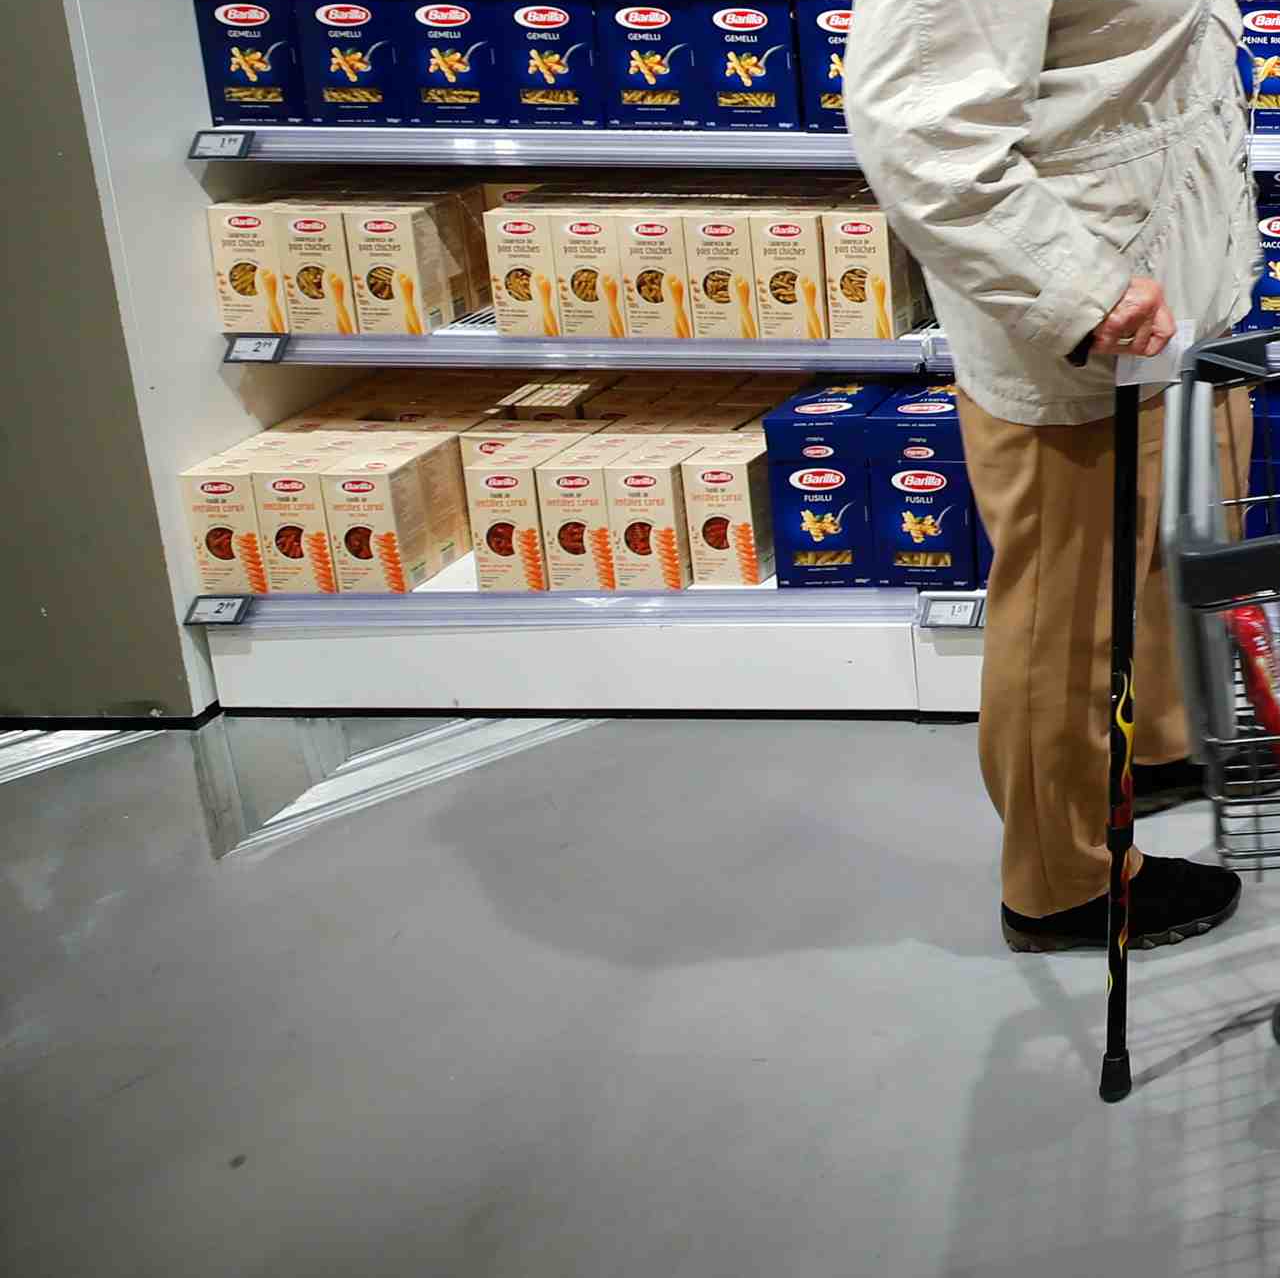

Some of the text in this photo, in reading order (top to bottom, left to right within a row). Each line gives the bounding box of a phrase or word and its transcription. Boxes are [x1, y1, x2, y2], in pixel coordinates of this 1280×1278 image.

[226, 8, 267, 21] Barilla
[227, 30, 261, 39] GEMELLI
[505, 223, 534, 233] Barilla
[803, 474, 840, 485] Barilla
[804, 494, 833, 502] FUSILLI
